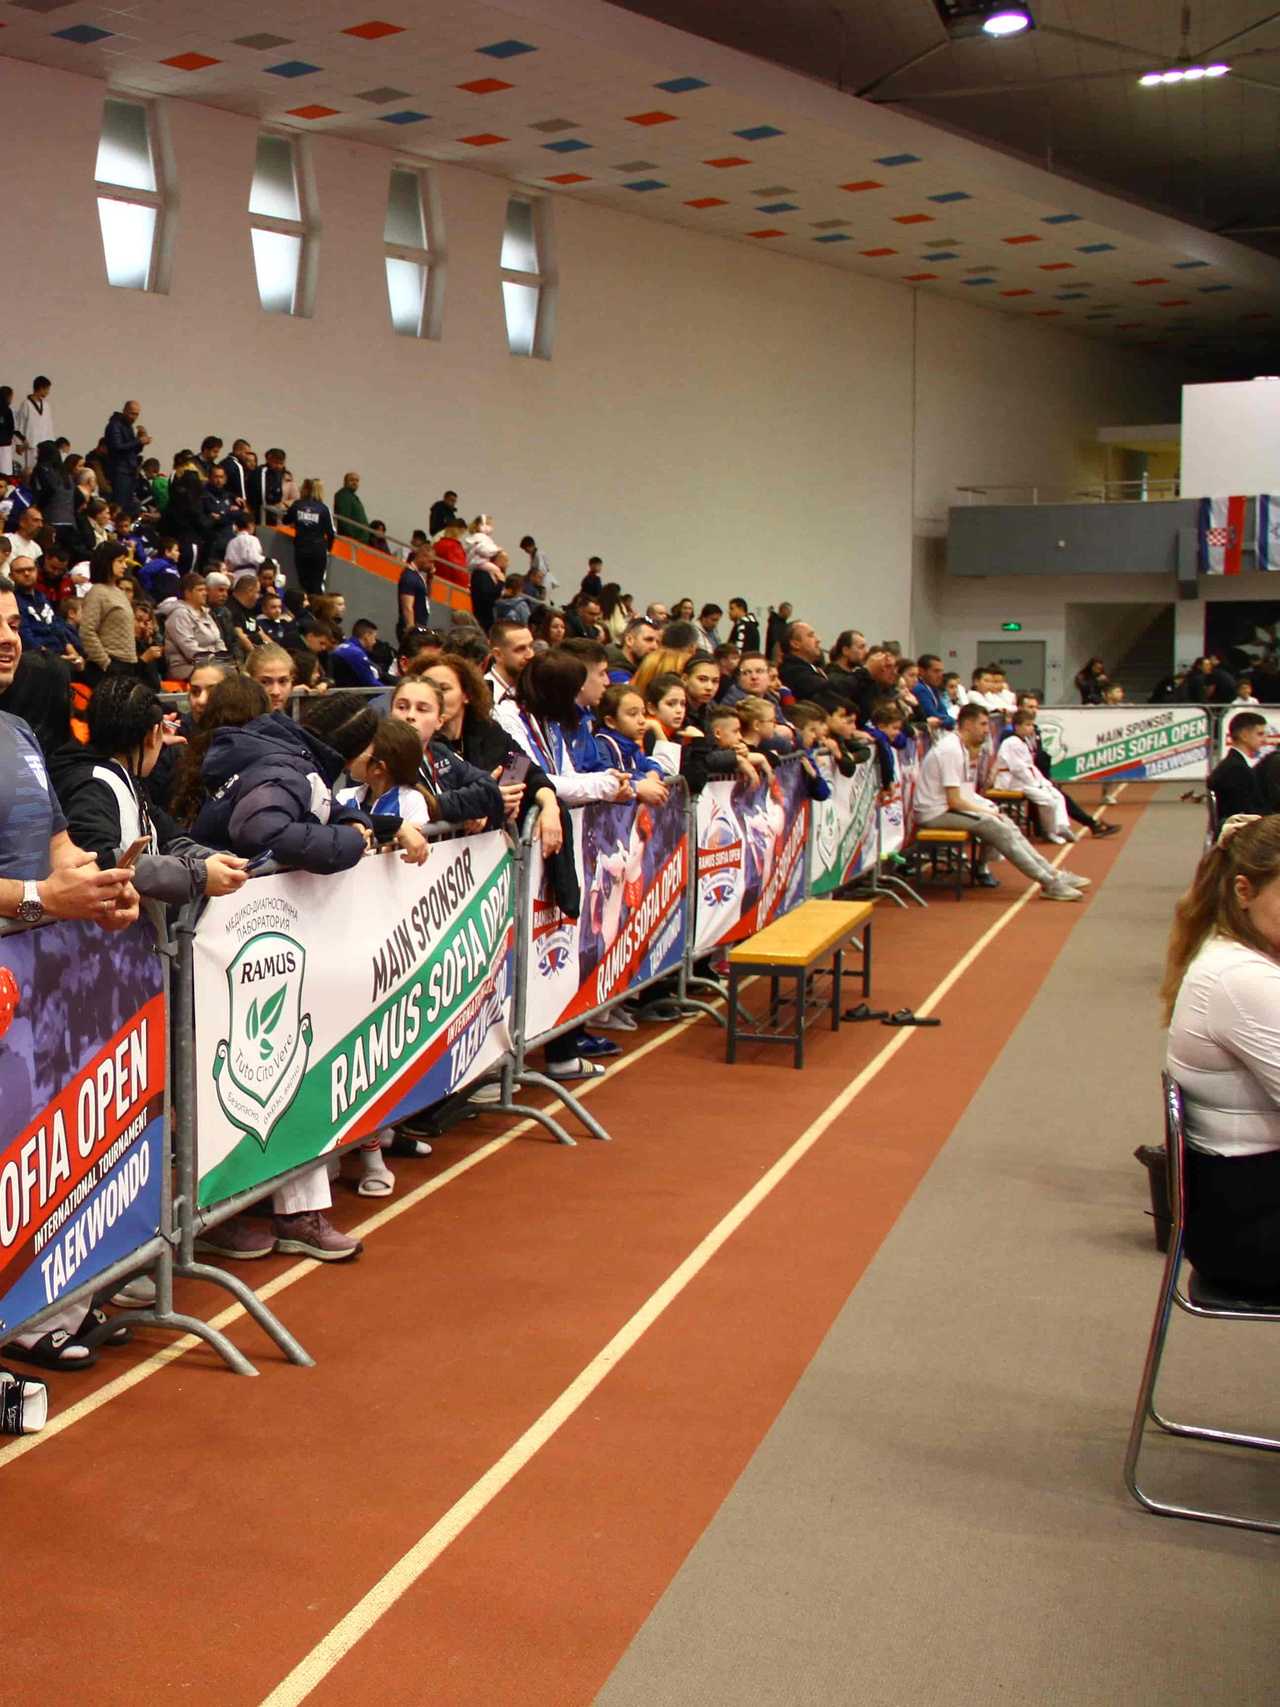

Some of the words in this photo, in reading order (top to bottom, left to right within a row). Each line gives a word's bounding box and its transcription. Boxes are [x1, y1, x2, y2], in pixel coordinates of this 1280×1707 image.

[1076, 743, 1126, 773] RAMUS
[1128, 730, 1169, 757] SOFIA
[1171, 718, 1207, 743] OPEN
[1096, 725, 1123, 746] MAIN
[1126, 711, 1173, 737] SPONSOR
[240, 951, 297, 985] RAMUS
[330, 981, 424, 1124] RAMUS
[426, 916, 487, 1023] SOFIA
[480, 862, 512, 953] OPEN
[371, 918, 418, 1004] MAIN
[411, 846, 476, 952] SPONSOR
[596, 921, 633, 1005] RAMUS
[633, 881, 660, 951] SOFIA
[661, 846, 683, 909] OPEN
[77, 1017, 149, 1158] OPEN
[235, 1047, 255, 1081] Tuto
[256, 1065, 274, 1082] Cito
[273, 1034, 294, 1069] Vere
[34, 1170, 98, 1256] INTERNATIONAL
[98, 1106, 149, 1178] TOURNAMENT
[40, 1139, 150, 1305] TAEKWONDO
